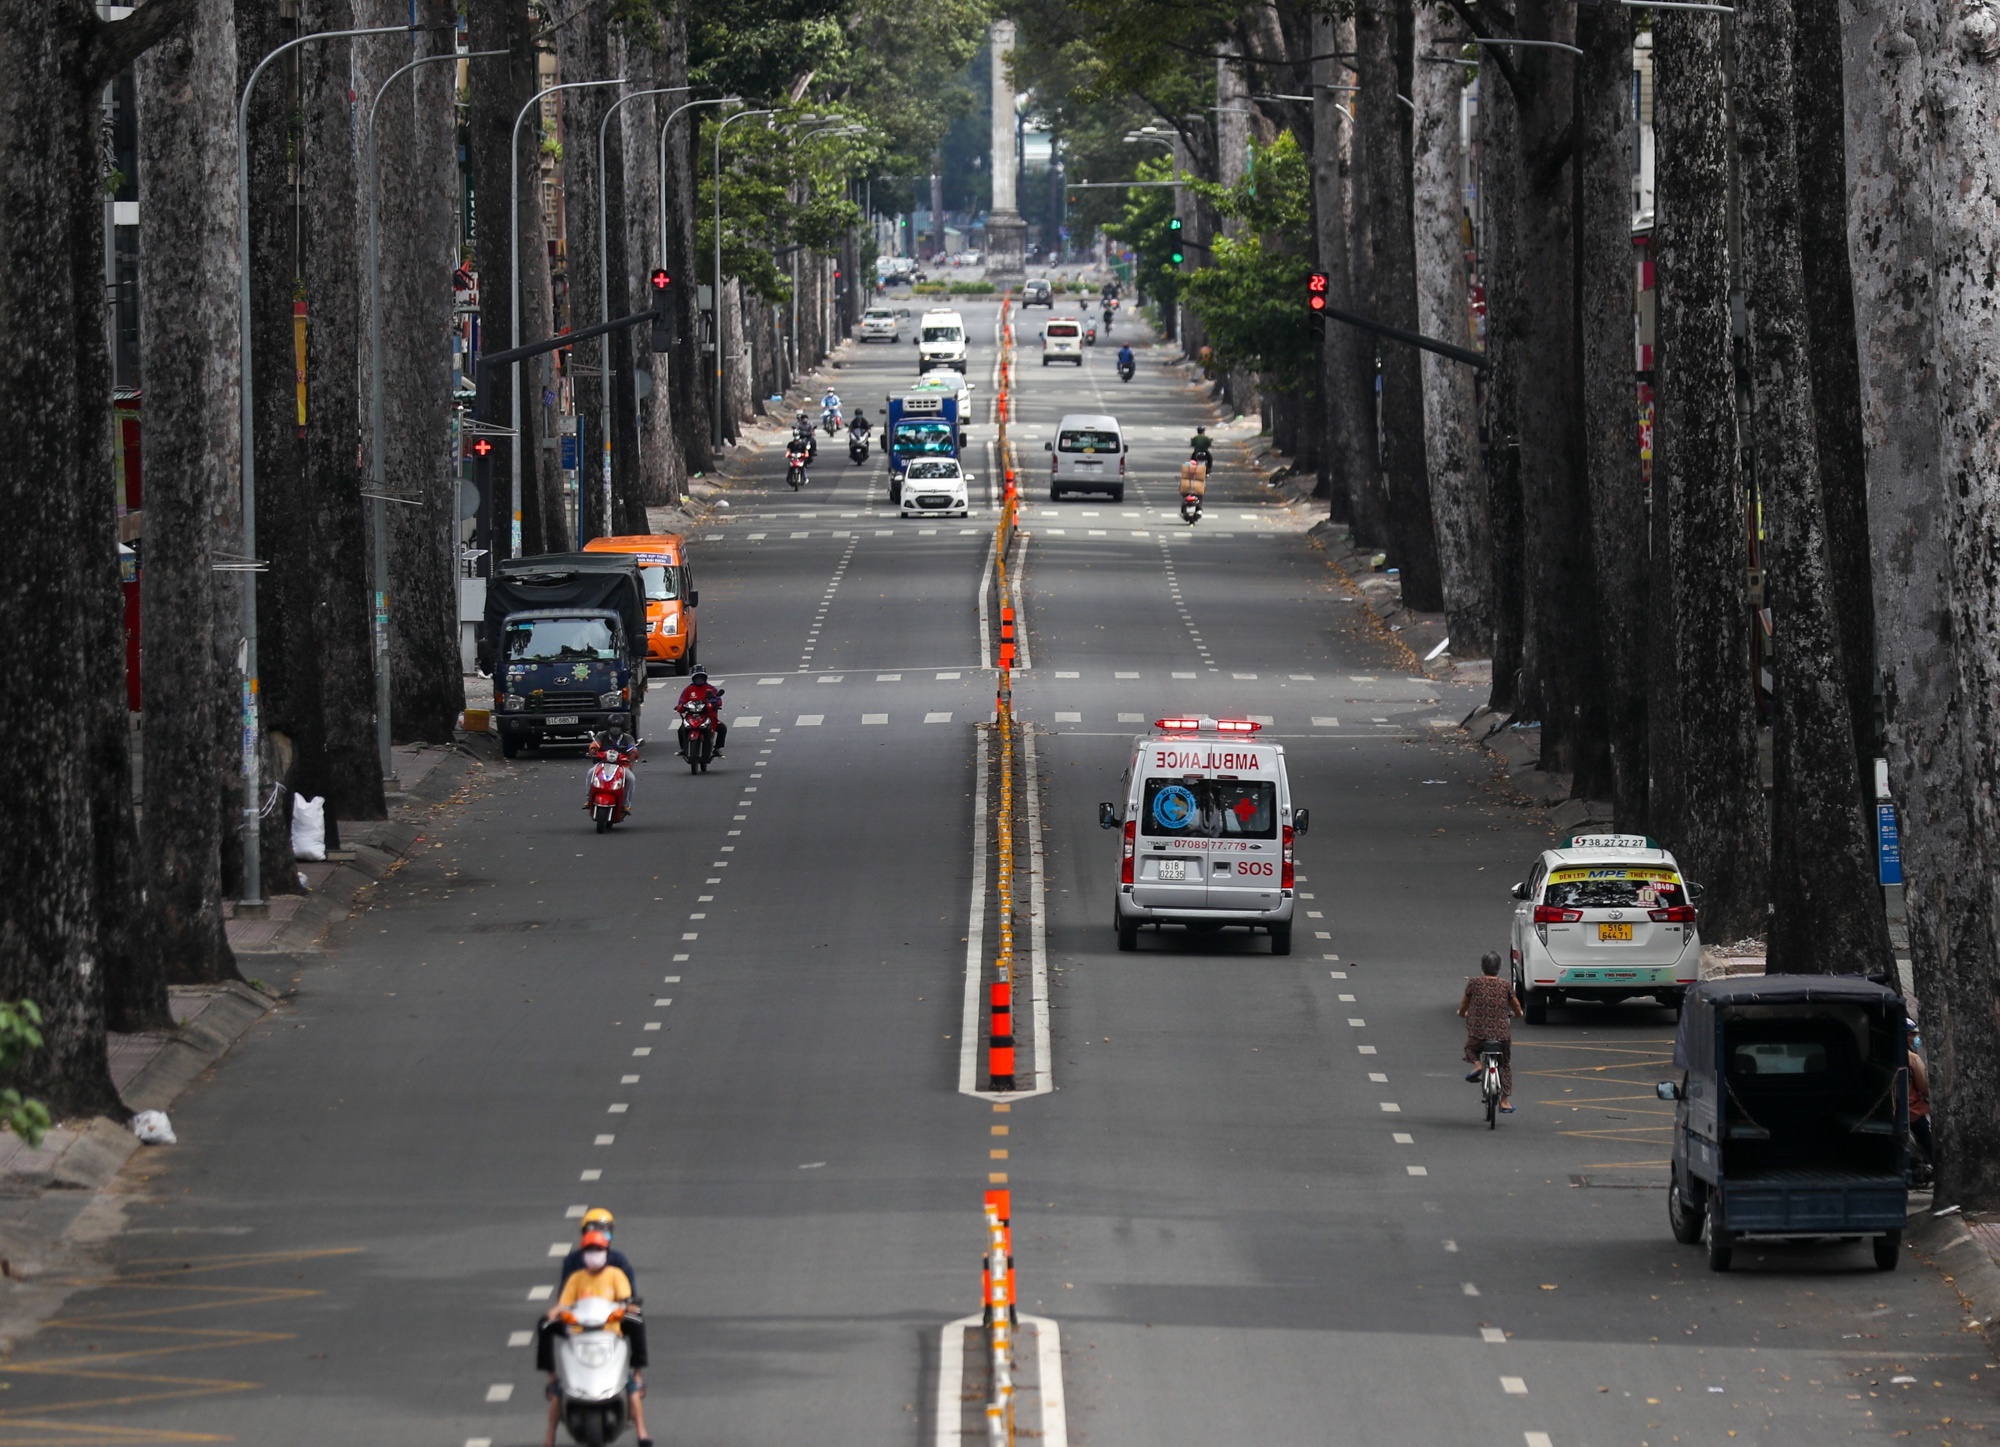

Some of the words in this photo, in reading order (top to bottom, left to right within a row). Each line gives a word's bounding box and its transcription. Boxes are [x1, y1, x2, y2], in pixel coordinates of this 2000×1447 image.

[1310, 275, 1326, 291] 22
[1165, 862, 1179, 870] 61B
[1238, 862, 1273, 876] SOS
[1588, 870, 1628, 878] MPE
[1653, 883, 1674, 891] 10400
[1602, 931, 1628, 939] 644.71
